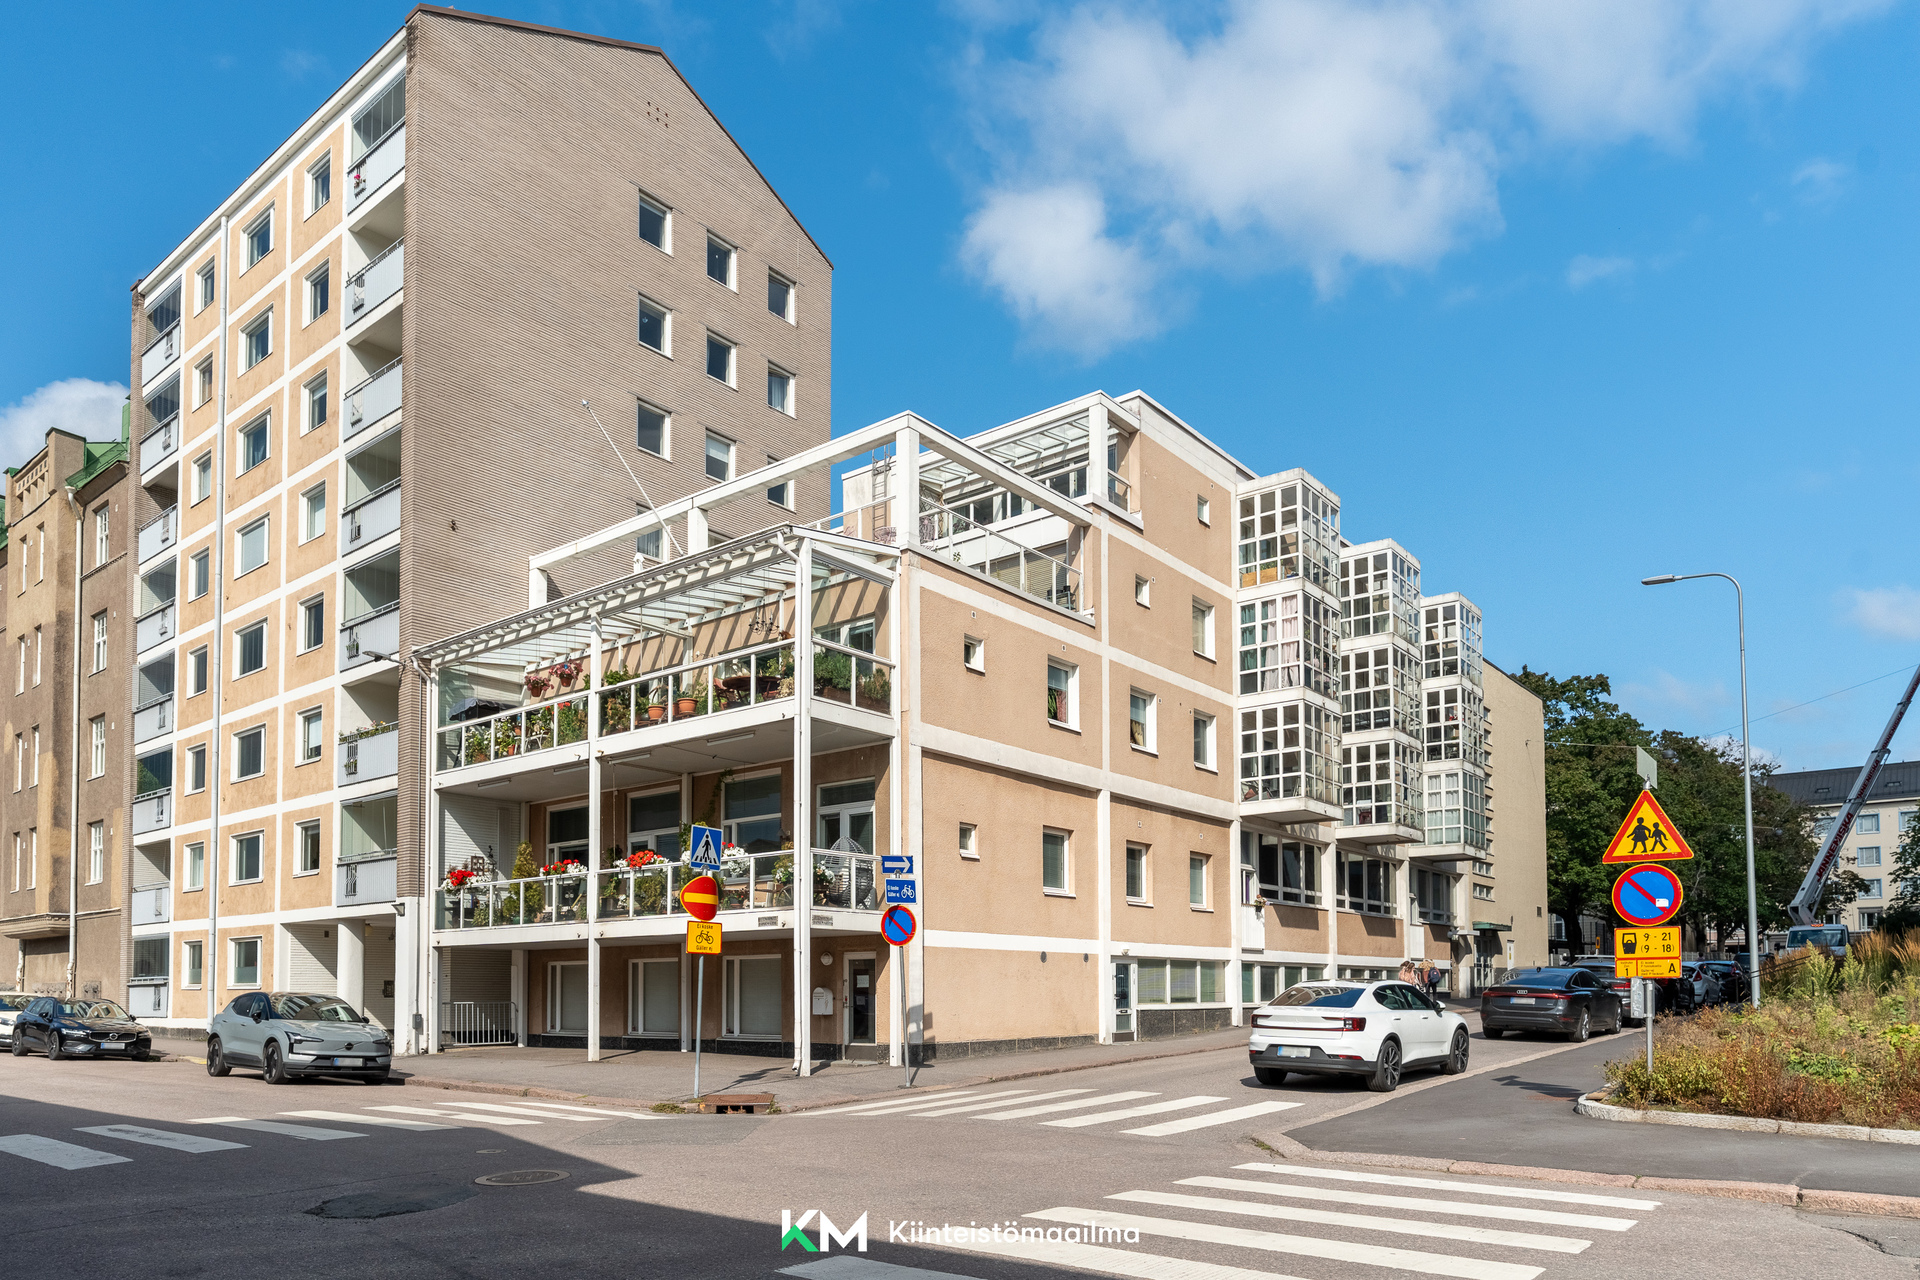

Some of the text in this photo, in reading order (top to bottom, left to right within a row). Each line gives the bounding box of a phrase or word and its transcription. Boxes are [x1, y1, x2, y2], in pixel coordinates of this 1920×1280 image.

[1643, 933, 1650, 942] 9
[1661, 932, 1671, 941] 21
[1641, 944, 1650, 953] (9
[1662, 943, 1675, 953] 18)
[1625, 968, 1629, 976] 1
[1668, 963, 1677, 973] A
